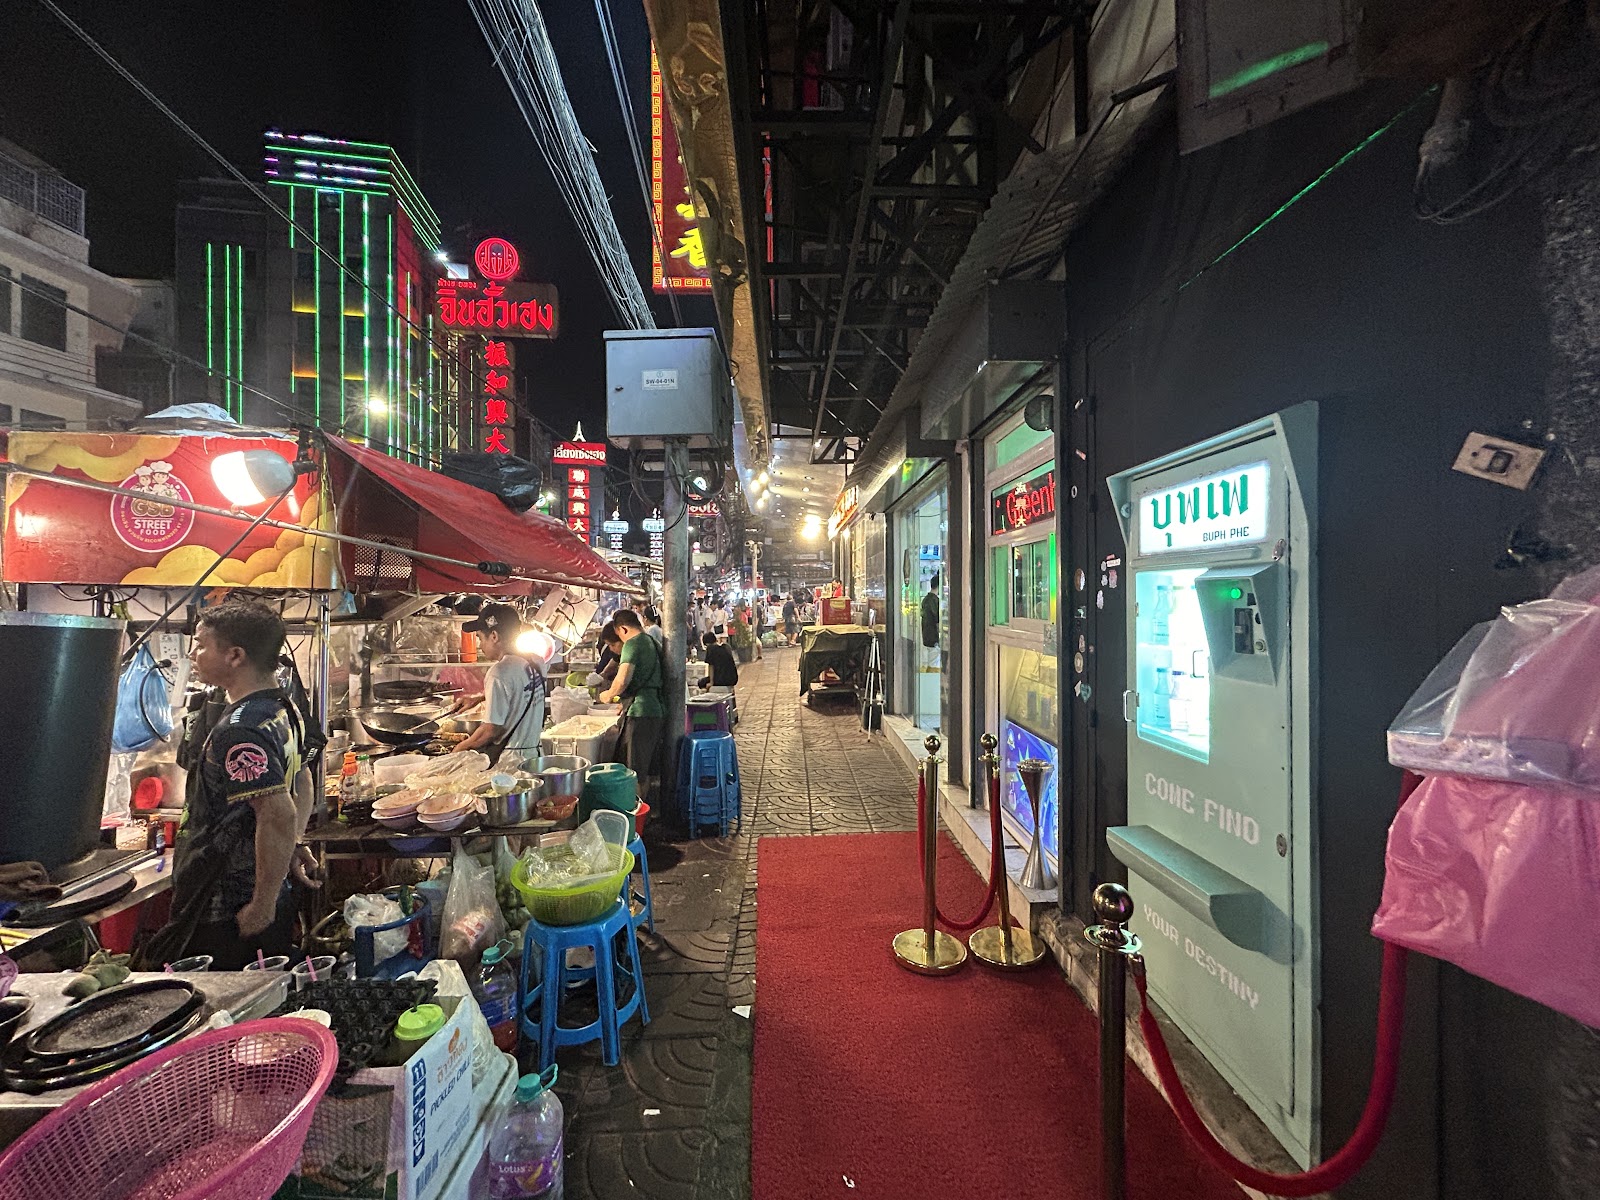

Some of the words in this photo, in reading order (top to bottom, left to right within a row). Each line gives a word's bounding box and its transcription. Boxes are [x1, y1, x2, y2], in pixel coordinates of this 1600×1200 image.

[131, 498, 175, 516] GSB
[134, 519, 172, 529] STREET
[572, 468, 587, 542] 聯成興大
[1151, 474, 1249, 547] บุพเพ
[1203, 530, 1226, 542] BUPH
[1230, 526, 1249, 538] PHE
[1145, 772, 1195, 814] COME
[1204, 798, 1260, 845] FIND
[1144, 903, 1179, 946] YOUR
[1184, 937, 1260, 1010] DESTINY
